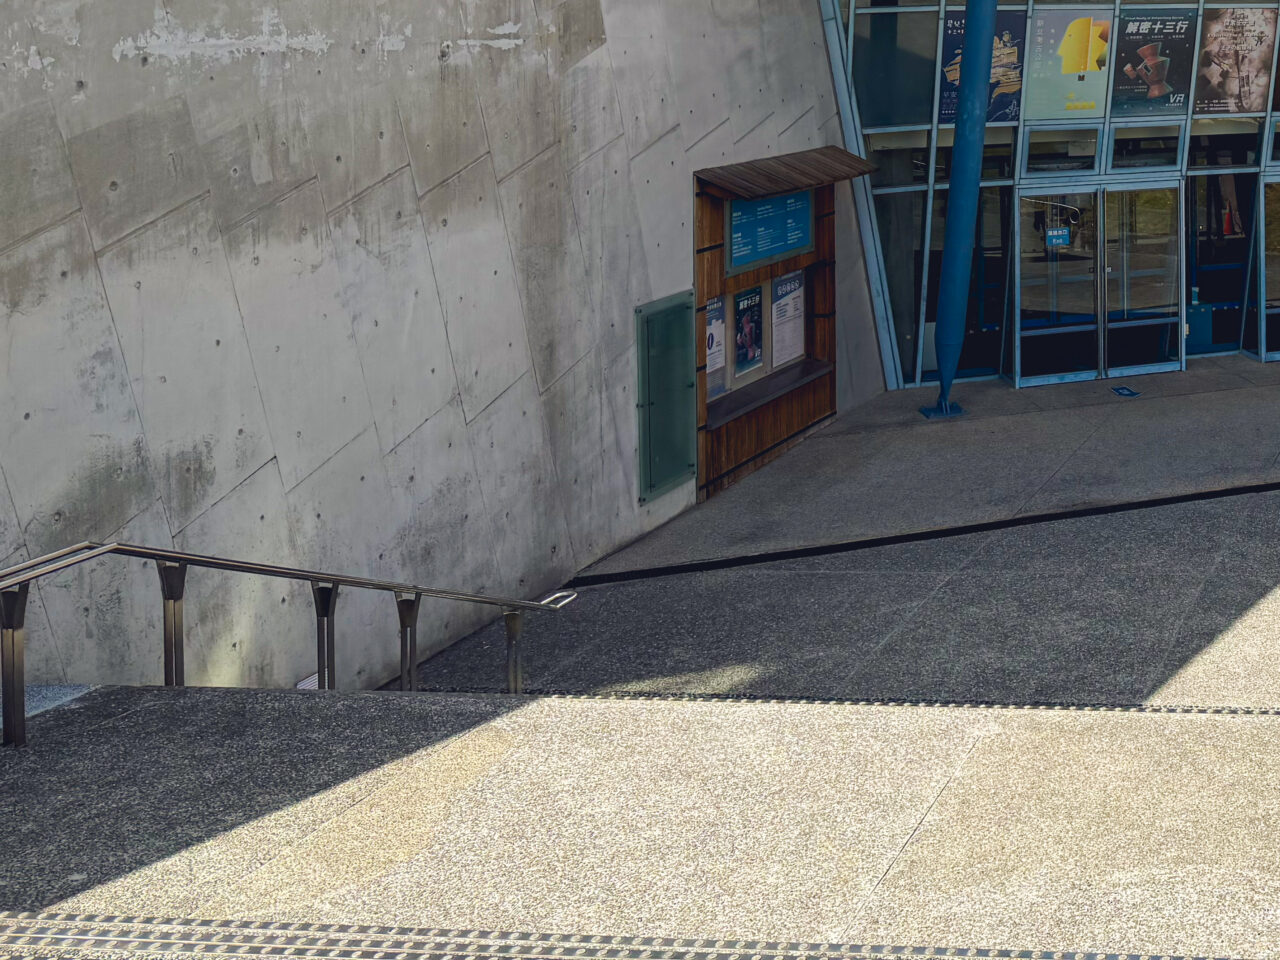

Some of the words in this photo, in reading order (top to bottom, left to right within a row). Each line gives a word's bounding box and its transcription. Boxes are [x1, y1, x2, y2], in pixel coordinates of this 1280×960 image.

[1125, 20, 1189, 34] 解密十三行
[1169, 93, 1185, 103] VR
